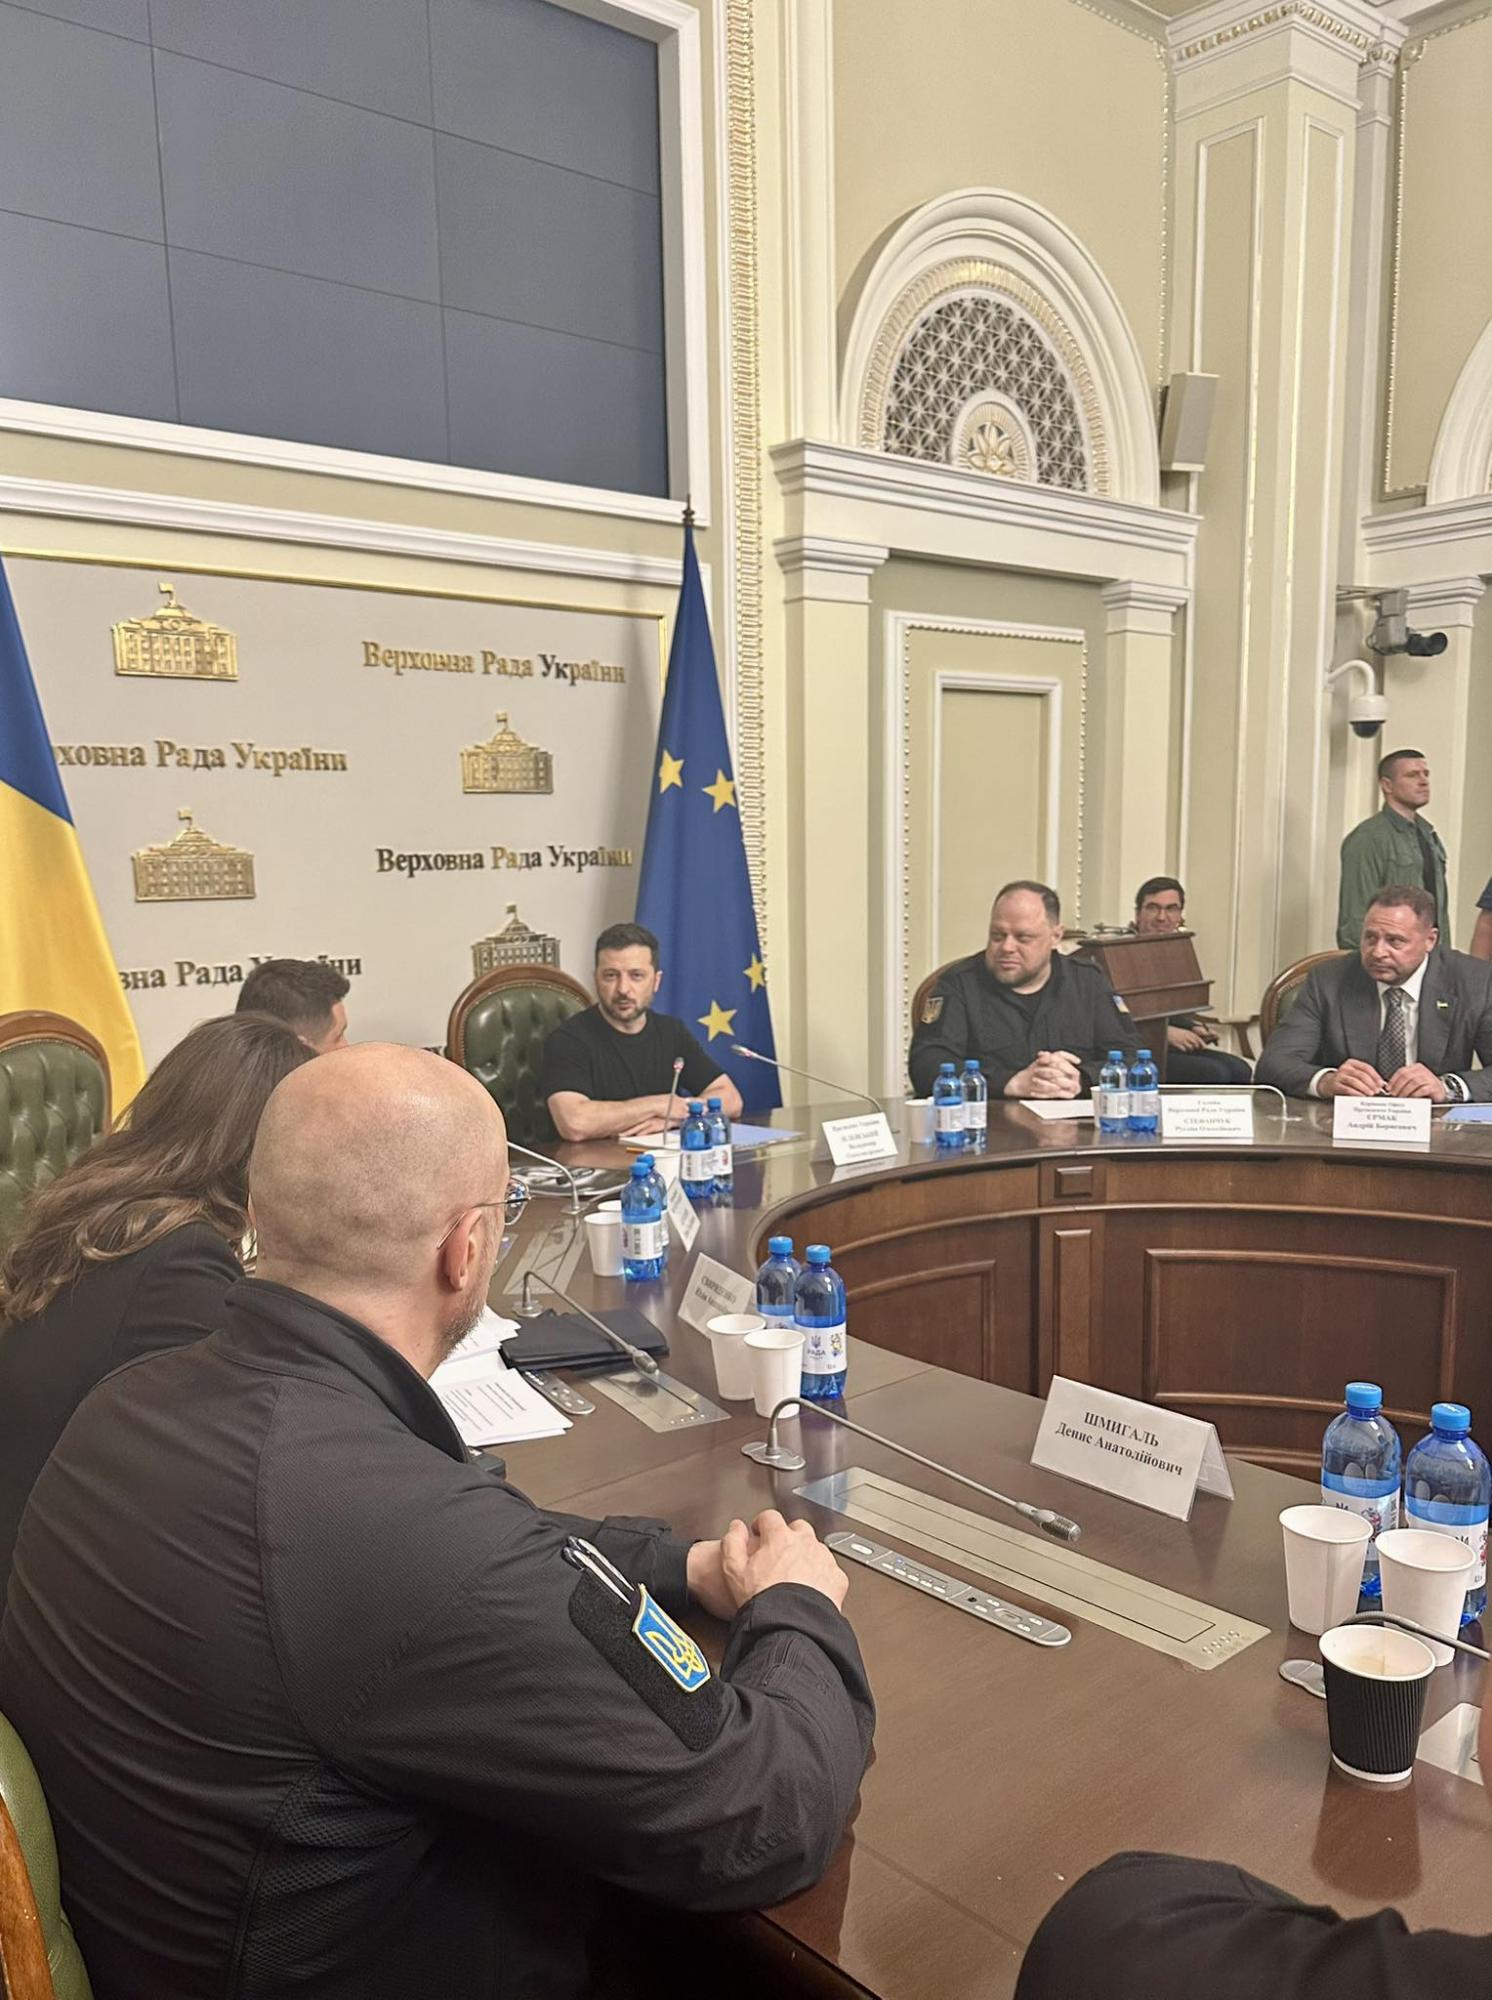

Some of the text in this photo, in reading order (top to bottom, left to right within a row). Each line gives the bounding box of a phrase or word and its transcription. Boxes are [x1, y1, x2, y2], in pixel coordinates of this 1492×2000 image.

[361, 640, 626, 686] Верховна Рада України
[55, 739, 348, 777] ховна Рада України
[375, 845, 633, 878] Верховна Рада України
[175, 961, 244, 987] Рада
[1084, 1411, 1160, 1448] ШМИГАЛЬ
[1055, 1422, 1183, 1476] Денис Анатолійович
